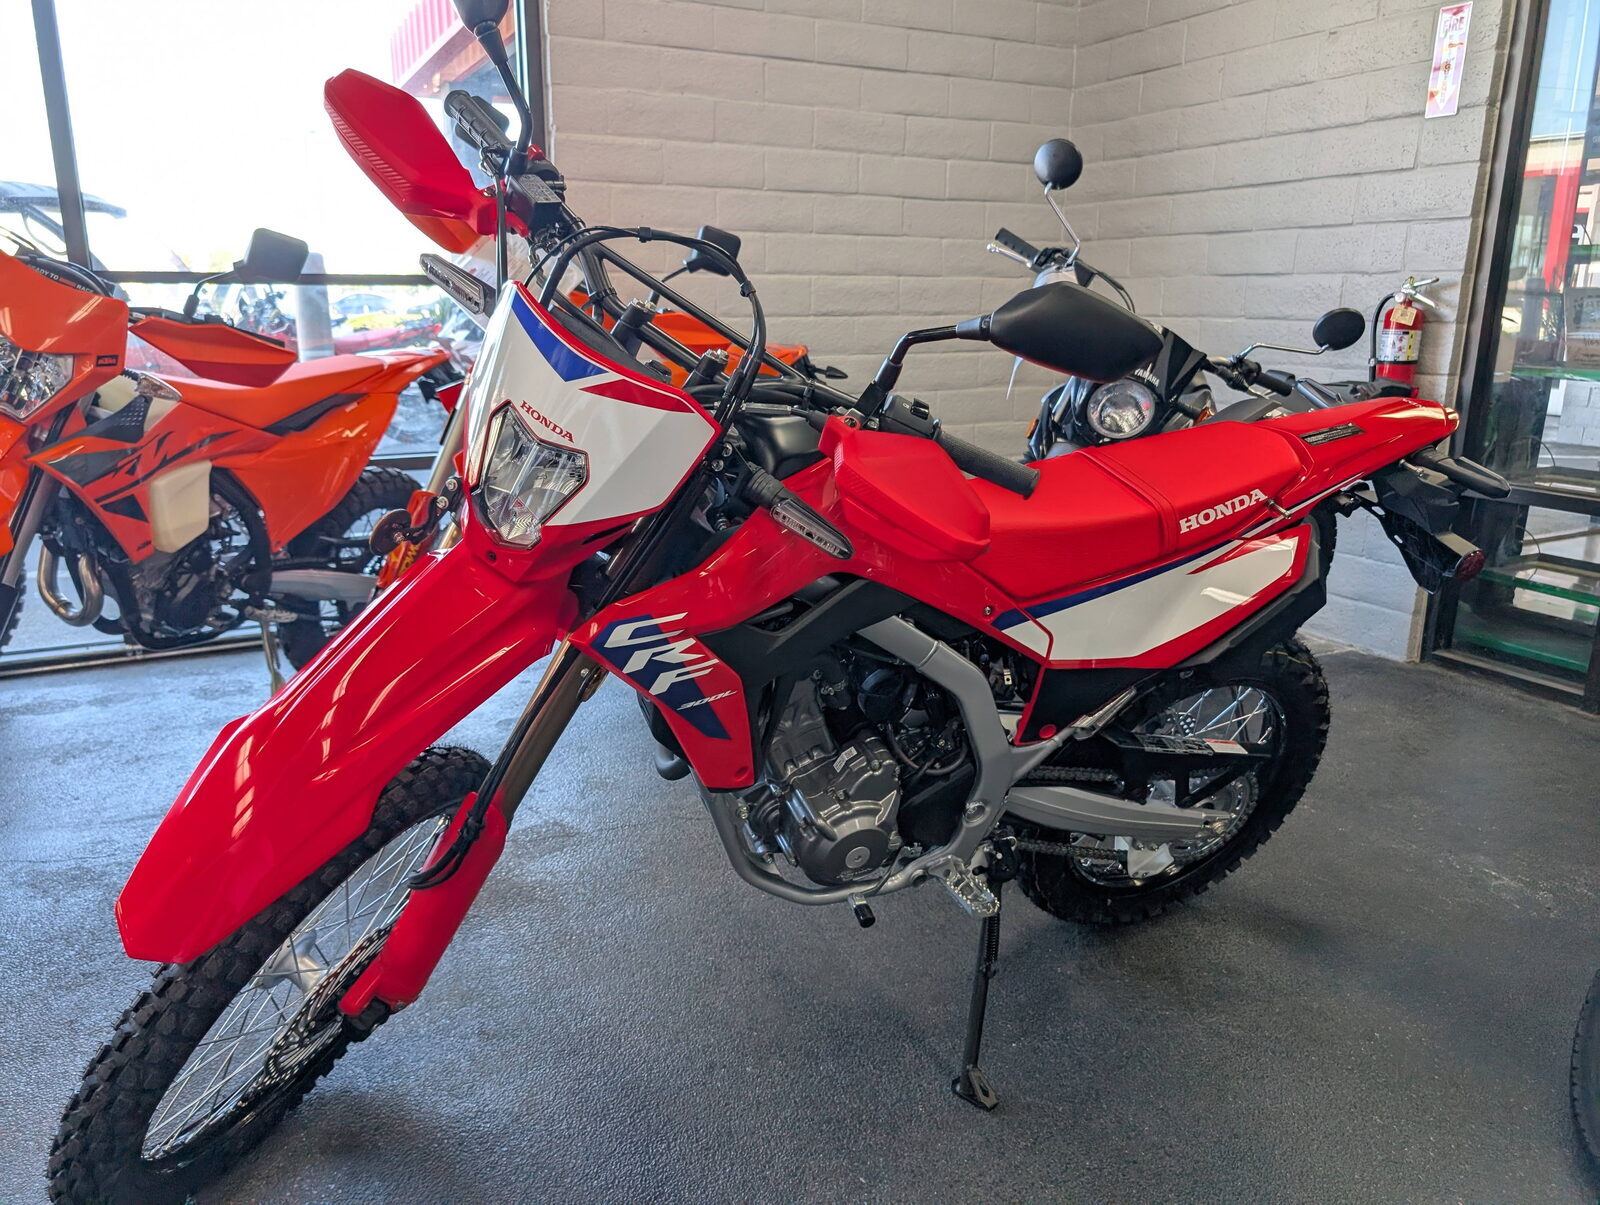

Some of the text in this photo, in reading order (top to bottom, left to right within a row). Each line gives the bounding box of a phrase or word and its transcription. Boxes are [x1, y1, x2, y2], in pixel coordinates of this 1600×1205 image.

[520, 400, 575, 443] HONDA
[1179, 488, 1268, 534] HONDA
[604, 612, 720, 696] CRF
[676, 690, 738, 711] 300L
